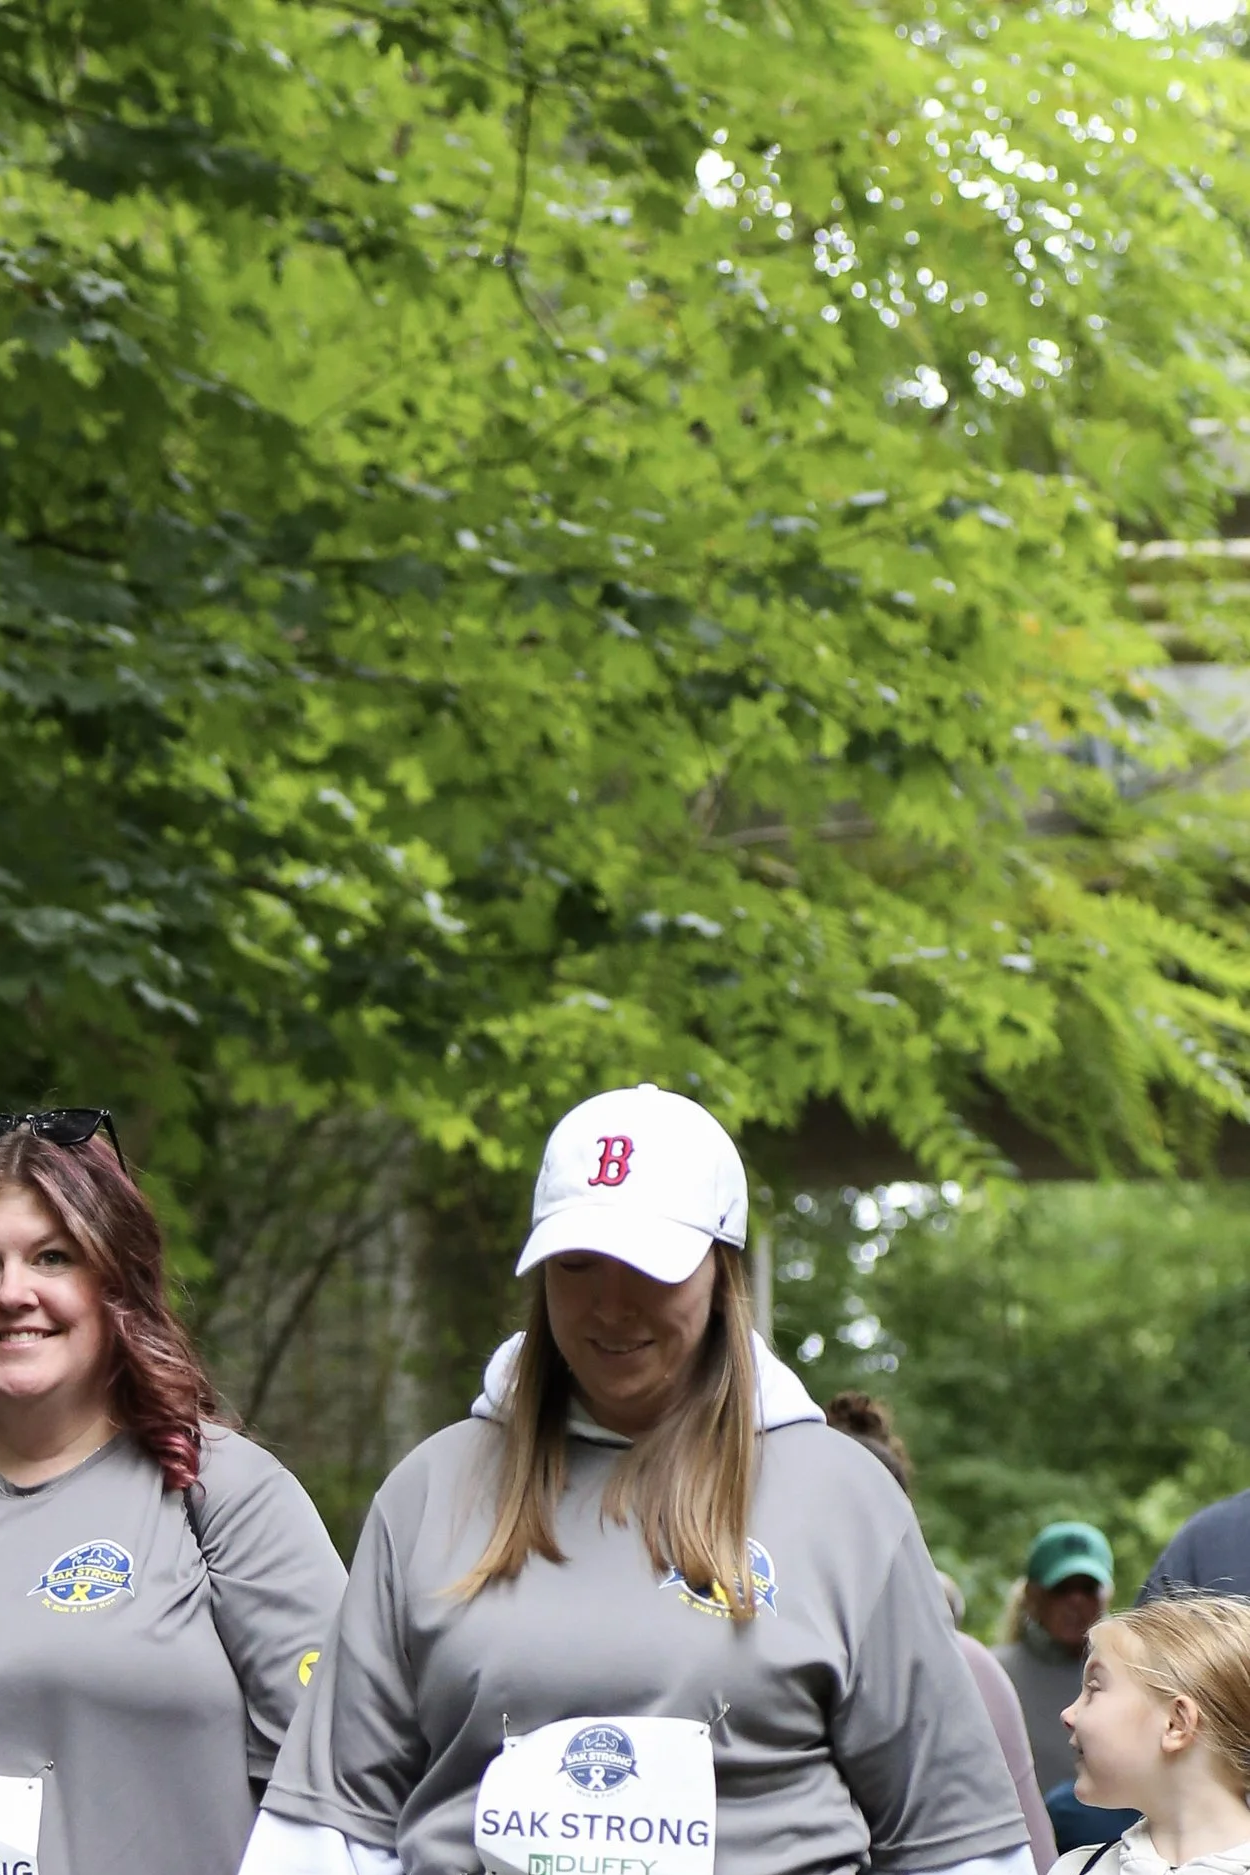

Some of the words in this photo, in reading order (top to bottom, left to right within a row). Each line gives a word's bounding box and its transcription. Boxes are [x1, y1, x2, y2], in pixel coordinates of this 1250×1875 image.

[588, 1135, 635, 1187] B
[47, 1570, 74, 1583] SAK
[75, 1567, 128, 1582] STRONG
[566, 1752, 588, 1765] SAK
[588, 1752, 633, 1768] STRONG
[481, 1809, 550, 1838] SAK
[561, 1813, 709, 1847] STRONG
